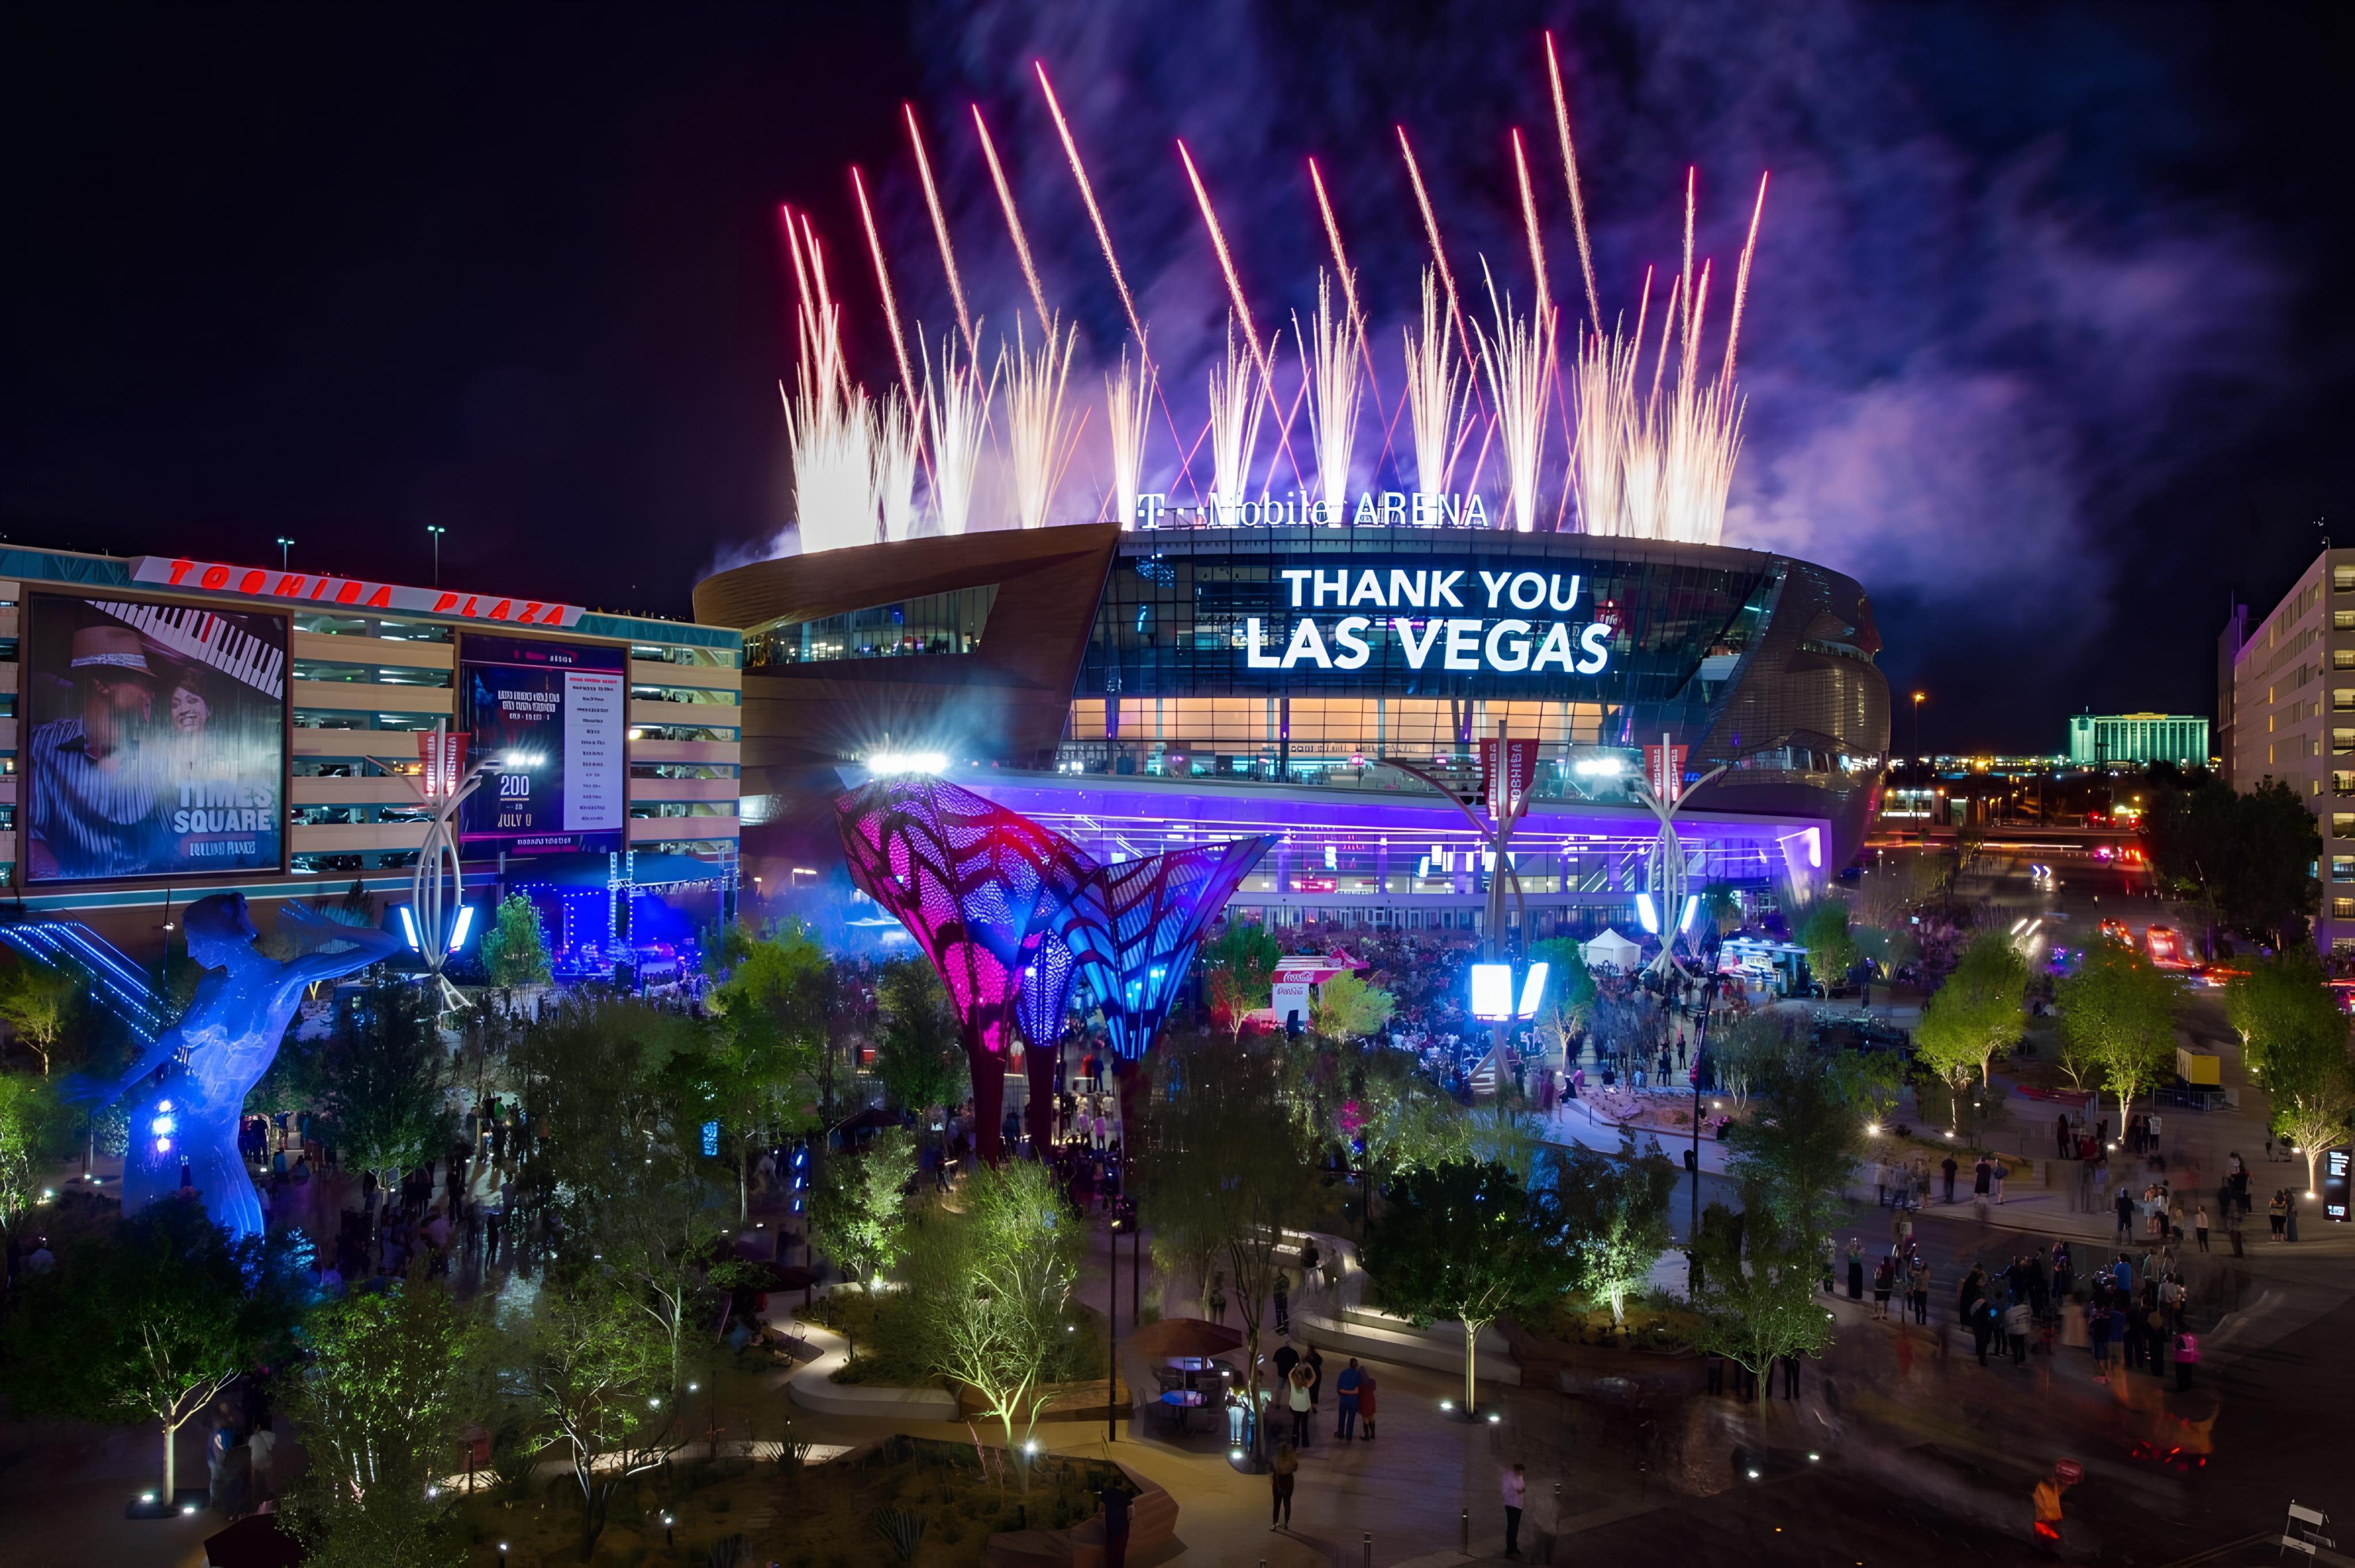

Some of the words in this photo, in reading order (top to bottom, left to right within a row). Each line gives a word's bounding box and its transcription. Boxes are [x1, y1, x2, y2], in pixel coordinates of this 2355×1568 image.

[1353, 492, 1489, 527] ARENA
[1282, 570, 1464, 607] THANK
[1479, 571, 1580, 611] YOU
[432, 593, 564, 626] PLAZA
[1247, 617, 1370, 670] LAS
[1390, 618, 1612, 674] VEGAS
[500, 775, 530, 795] 200
[1510, 743, 1522, 815] OSHIBA
[174, 809, 272, 833] SQUARE
[498, 814, 522, 827] JULY
